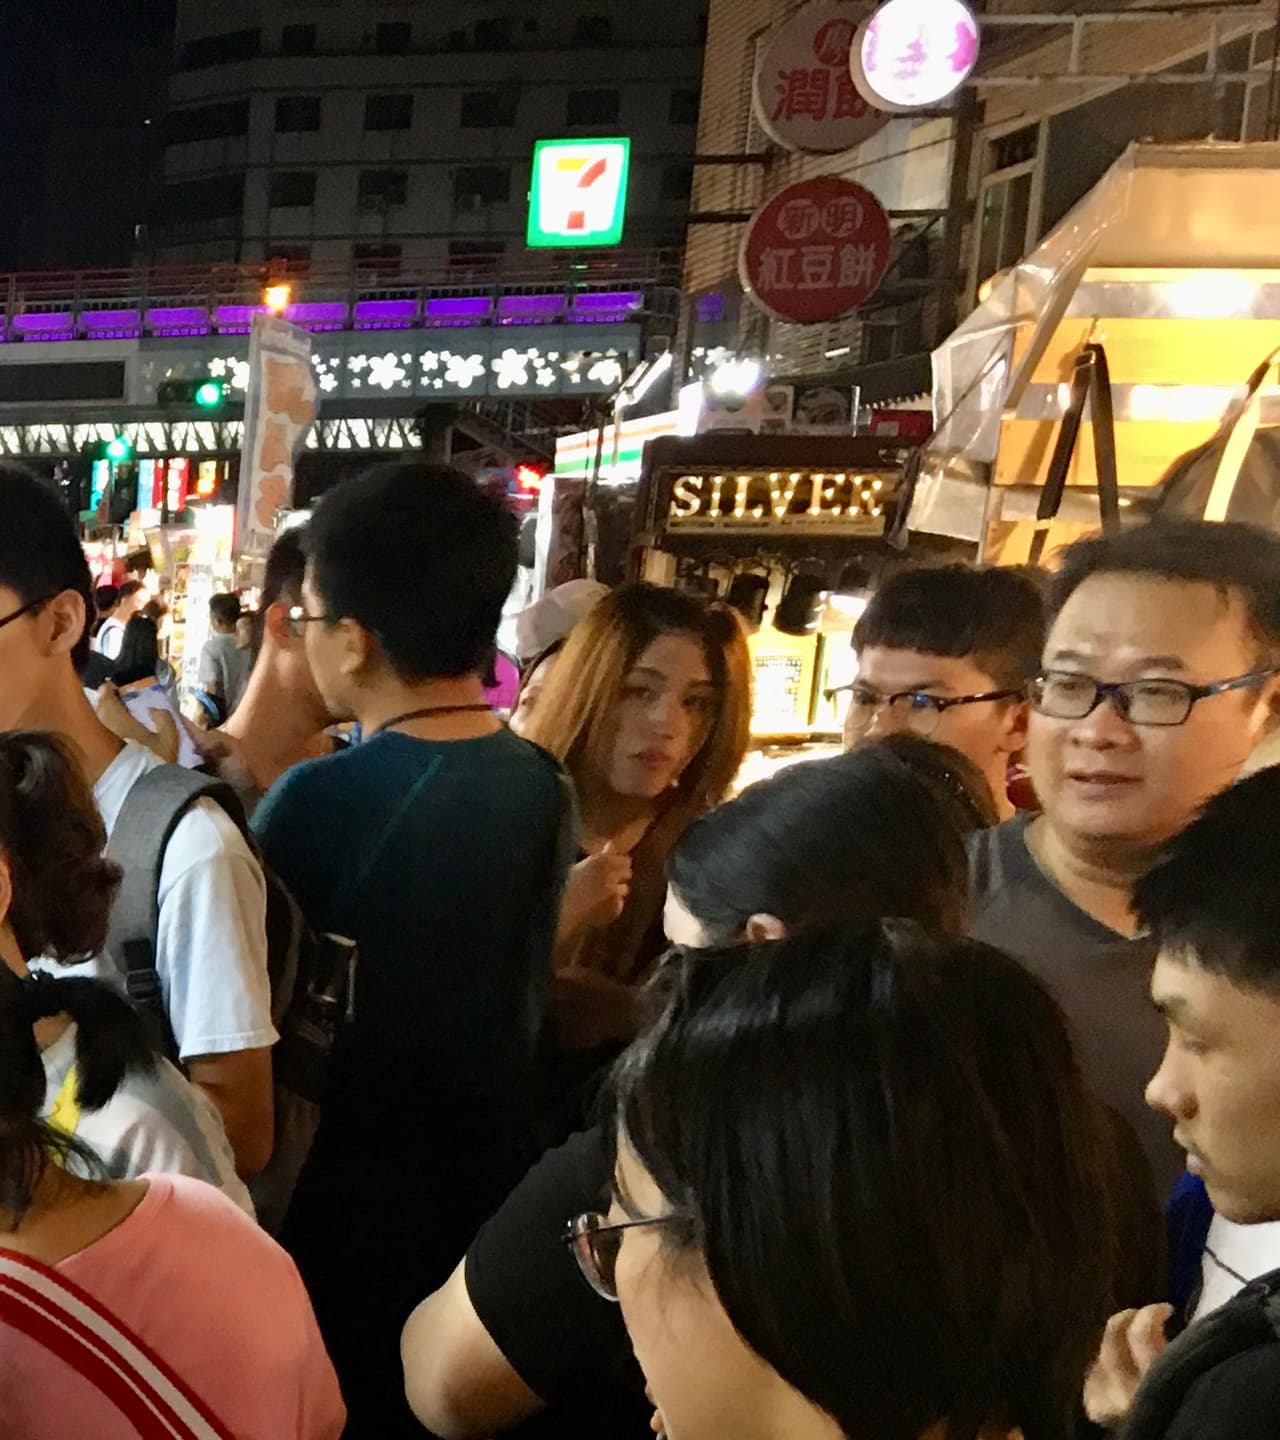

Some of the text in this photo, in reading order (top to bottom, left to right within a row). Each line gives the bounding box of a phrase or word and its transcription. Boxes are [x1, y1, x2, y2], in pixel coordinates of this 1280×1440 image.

[757, 243, 876, 290] 紅豆餅
[671, 471, 883, 517] SILVER
